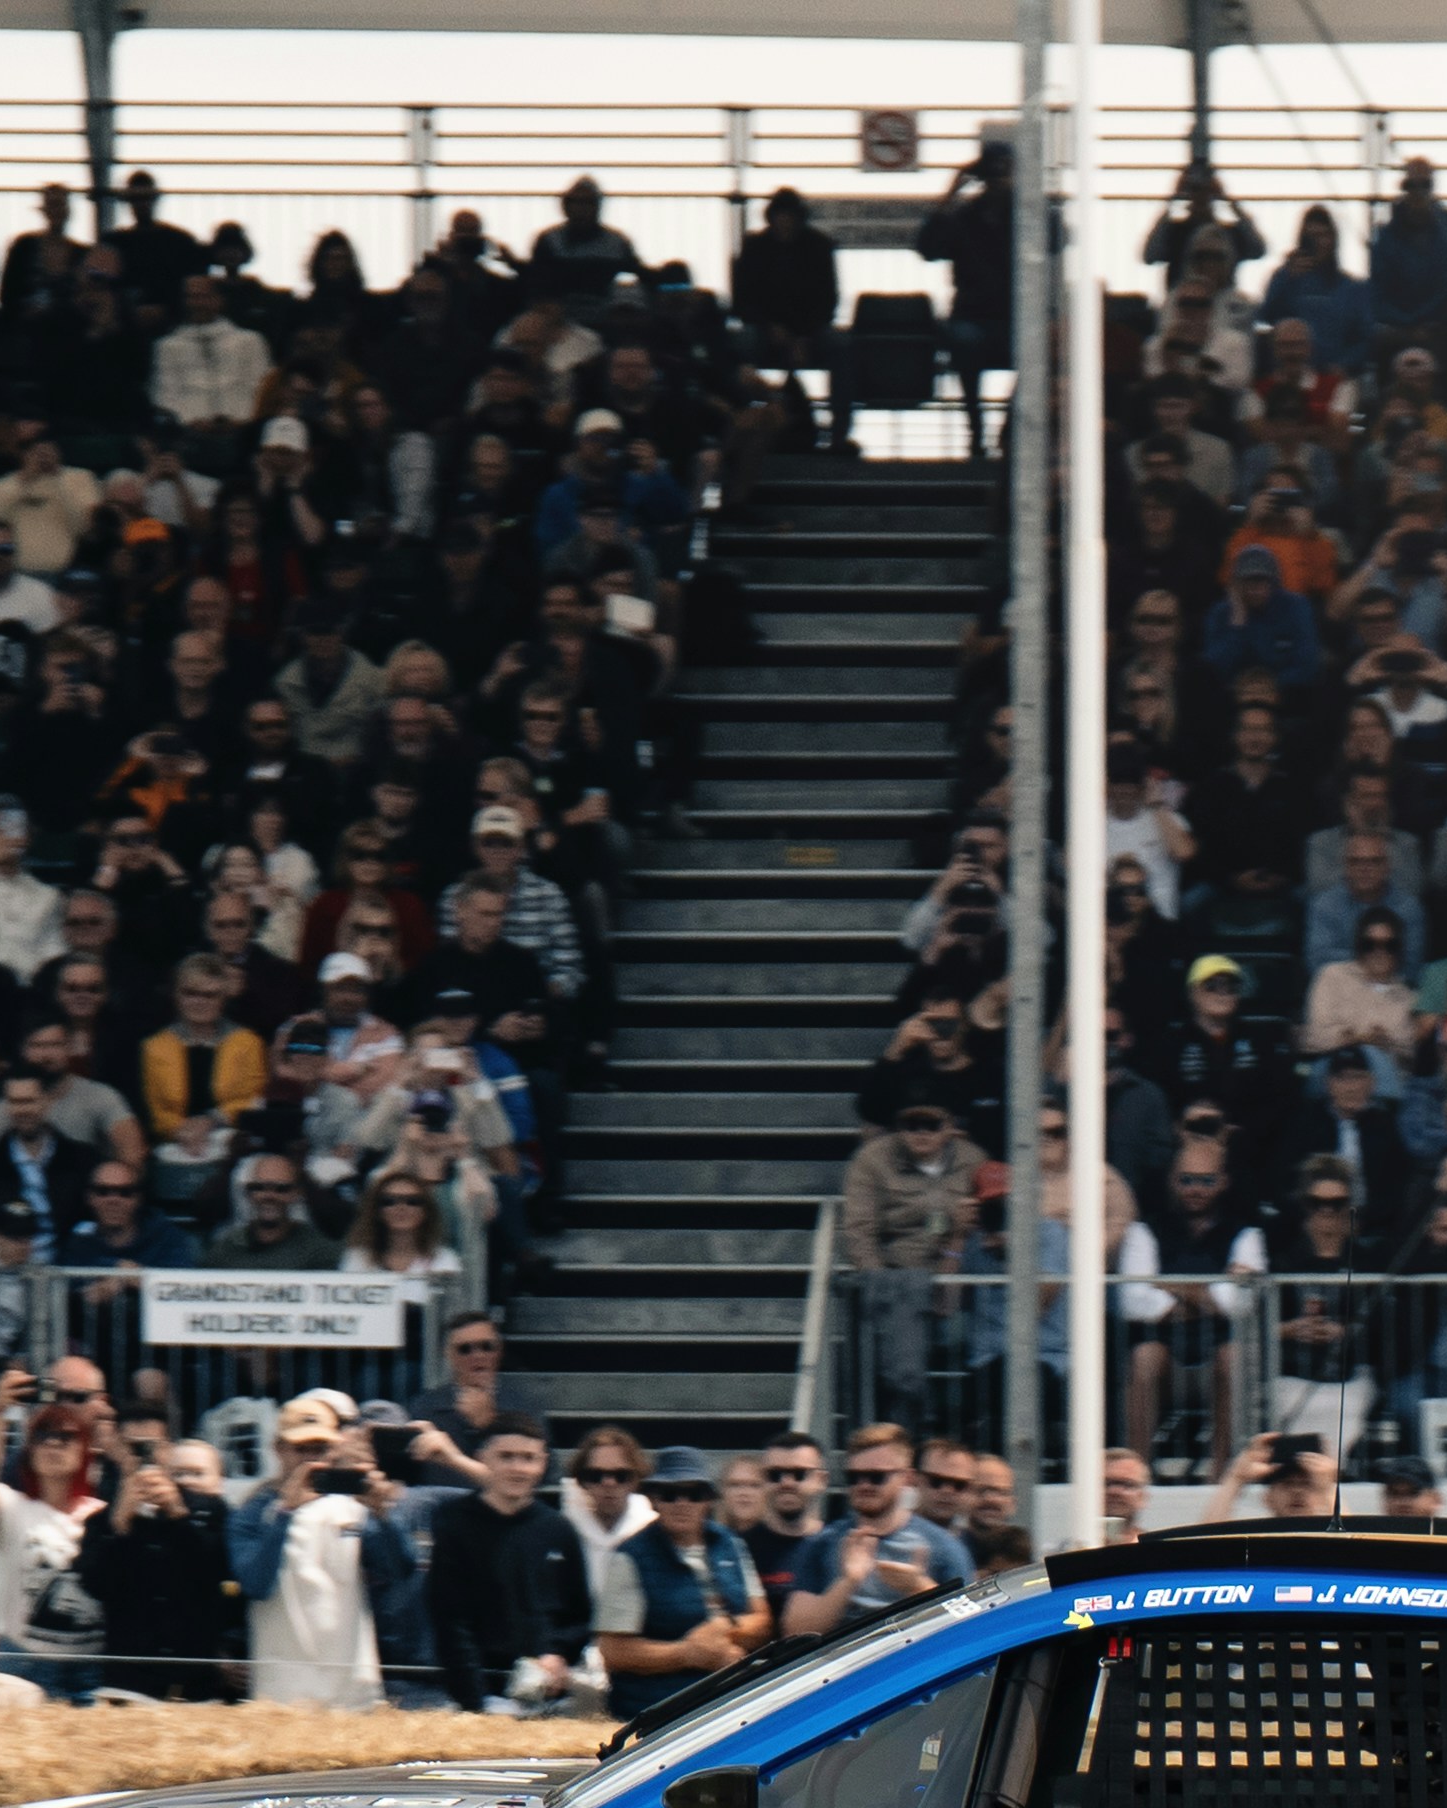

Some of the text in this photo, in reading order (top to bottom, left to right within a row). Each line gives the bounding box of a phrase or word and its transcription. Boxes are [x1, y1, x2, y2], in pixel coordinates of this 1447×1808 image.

[1116, 1585, 1254, 1610] J. BUTTON
[1317, 1585, 1337, 1603] J.
